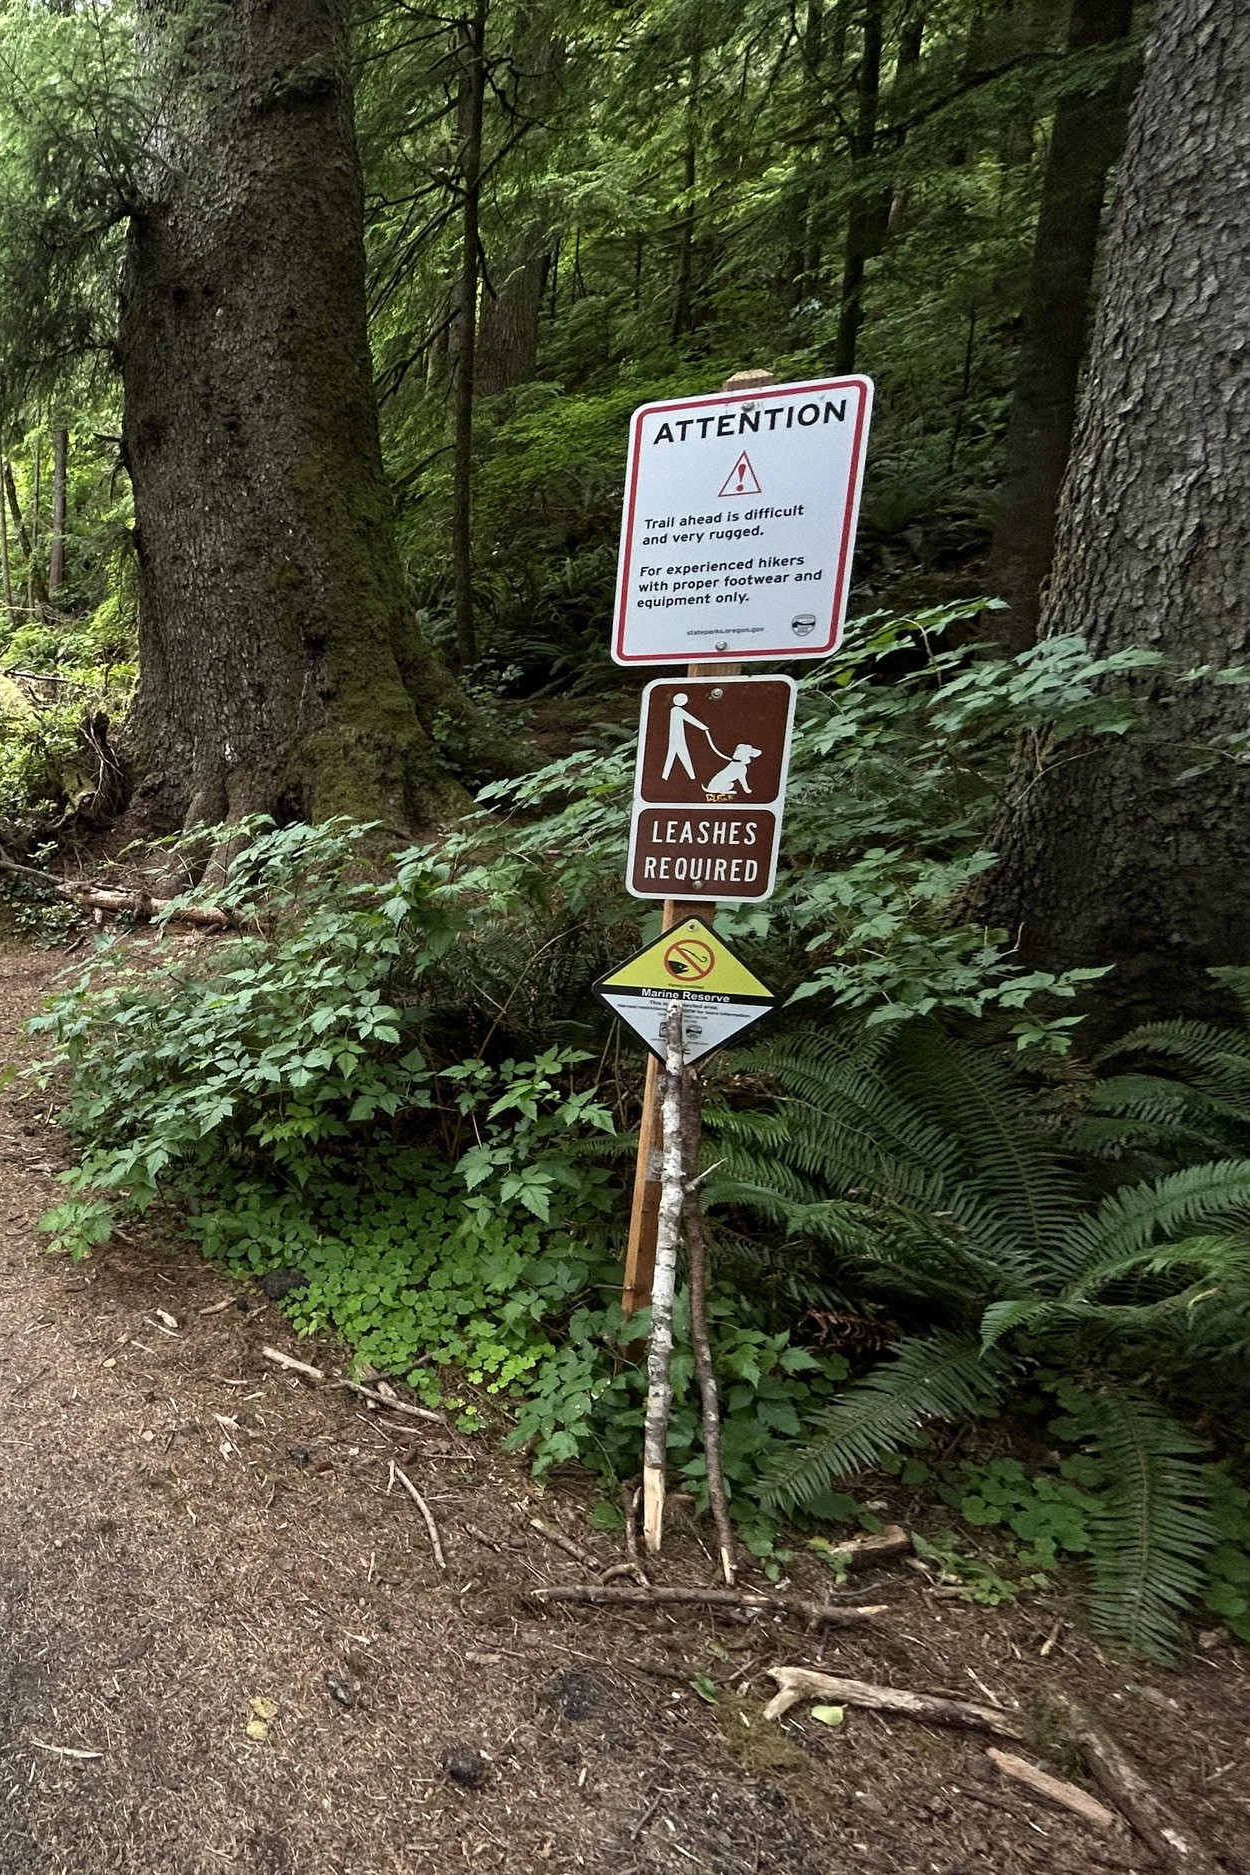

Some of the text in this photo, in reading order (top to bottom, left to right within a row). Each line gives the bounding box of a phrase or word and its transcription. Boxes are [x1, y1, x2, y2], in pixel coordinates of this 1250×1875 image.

[653, 399, 847, 445] ATTENTION
[645, 504, 805, 530] Trail ahead is difficult
[642, 525, 764, 546] and very rugged.
[640, 555, 805, 577] For experienced hikers
[638, 569, 822, 593] with proper footwear and
[637, 592, 750, 610] equipment only.
[686, 626, 764, 636] stateparks.oregon.gov
[652, 820, 758, 846] LEASHES
[643, 856, 759, 883] REQUIRED
[641, 988, 730, 1003] Marine Reserve
